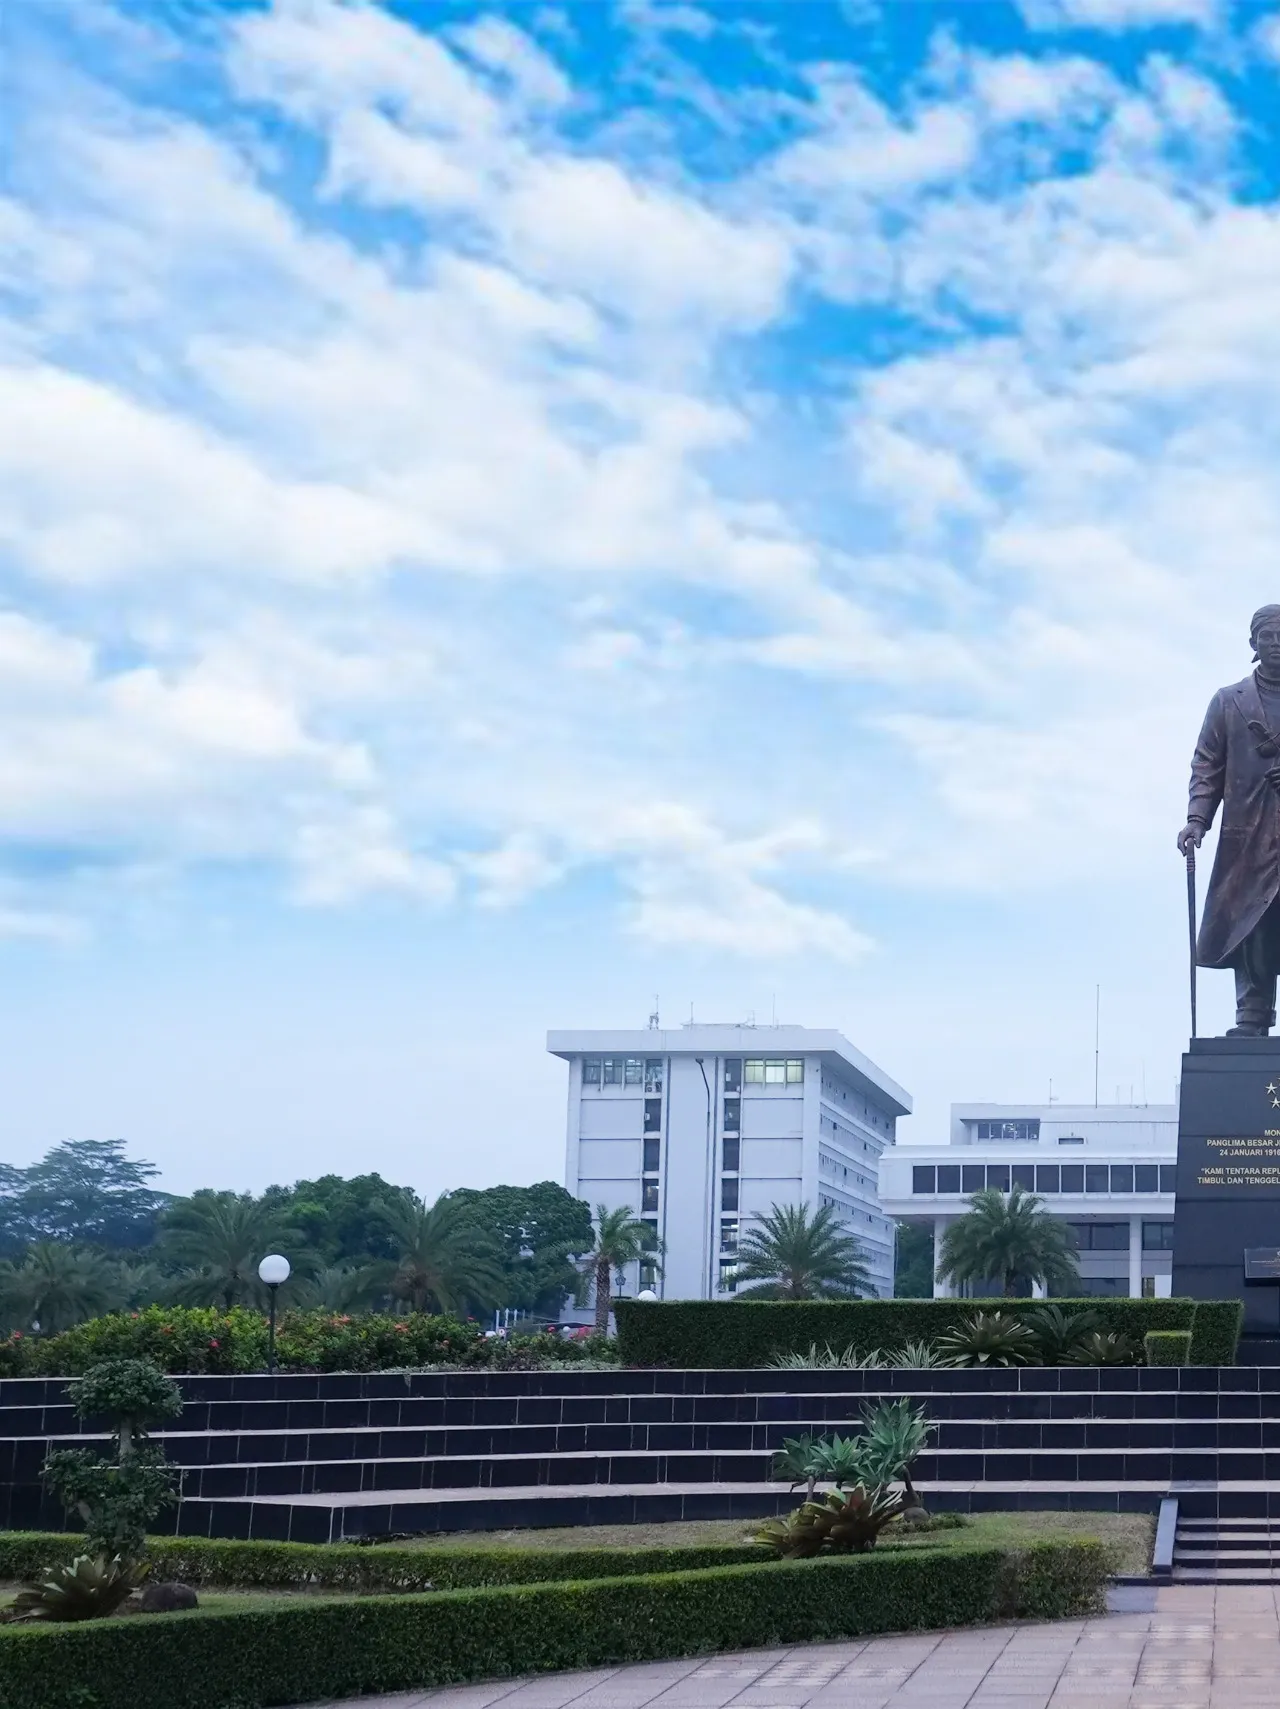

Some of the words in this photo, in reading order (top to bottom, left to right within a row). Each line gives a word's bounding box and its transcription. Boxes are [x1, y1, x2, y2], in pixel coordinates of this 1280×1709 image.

[1206, 1139, 1246, 1147] PANGLIMA
[1247, 1139, 1274, 1147] BESAR
[1219, 1148, 1229, 1156] 24
[1229, 1148, 1263, 1156] JANUARI
[1264, 1148, 1280, 1156] 1916
[1225, 1167, 1261, 1175] TENTARA
[1197, 1176, 1226, 1184] TIMBUL
[1227, 1176, 1244, 1184] DAN
